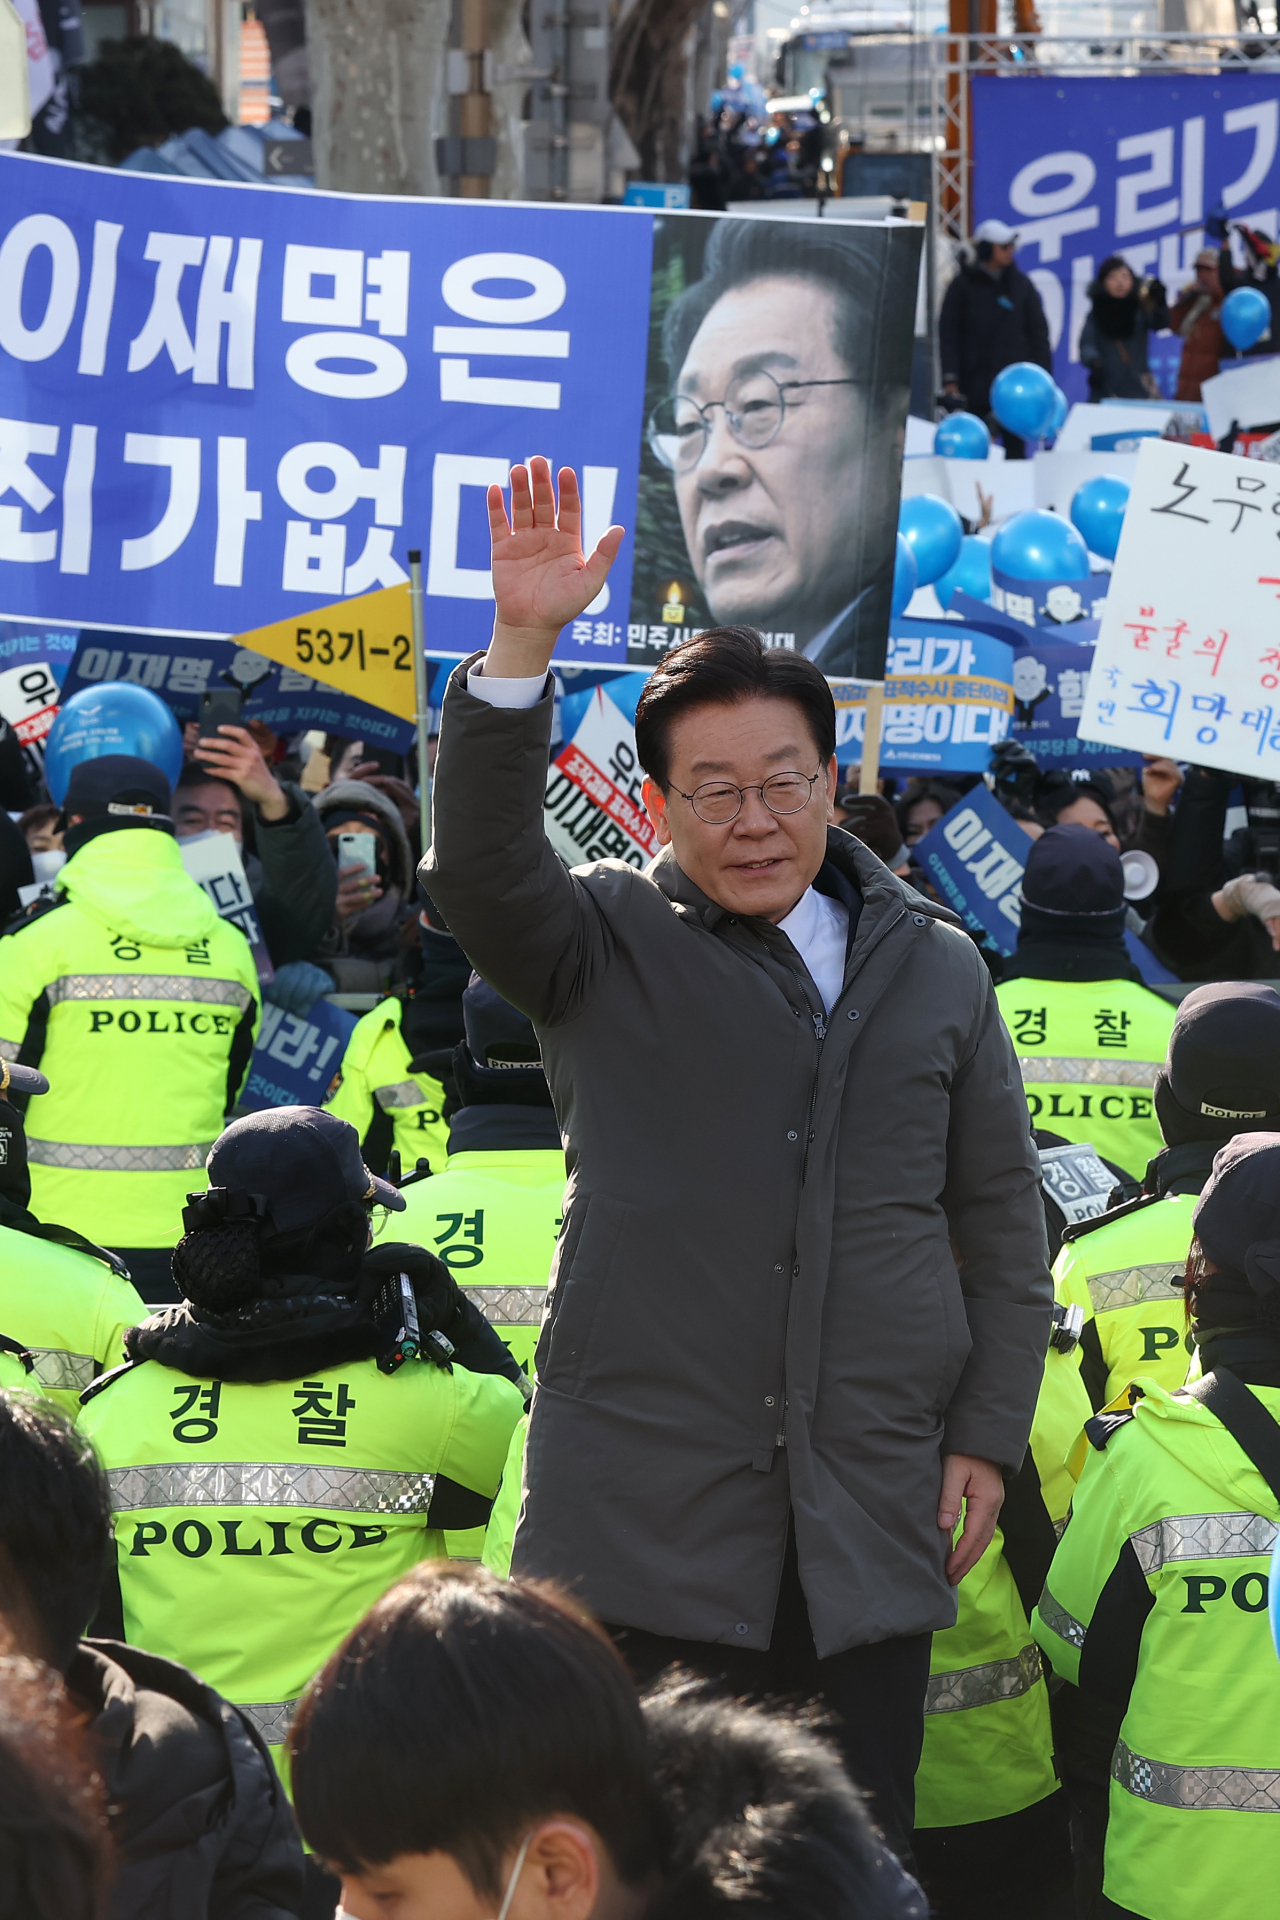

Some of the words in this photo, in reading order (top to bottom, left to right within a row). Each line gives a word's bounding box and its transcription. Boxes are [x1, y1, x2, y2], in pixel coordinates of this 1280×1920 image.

[0, 213, 571, 410] 이재명은
[296, 628, 412, 671] 53기-2
[572, 620, 621, 648] 주최:
[1123, 605, 1229, 677] 불굴의
[77, 647, 213, 694] 이재명
[884, 680, 950, 699] 표적수사
[88, 1010, 231, 1035] POLICE
[129, 1519, 388, 1558] POLICE
